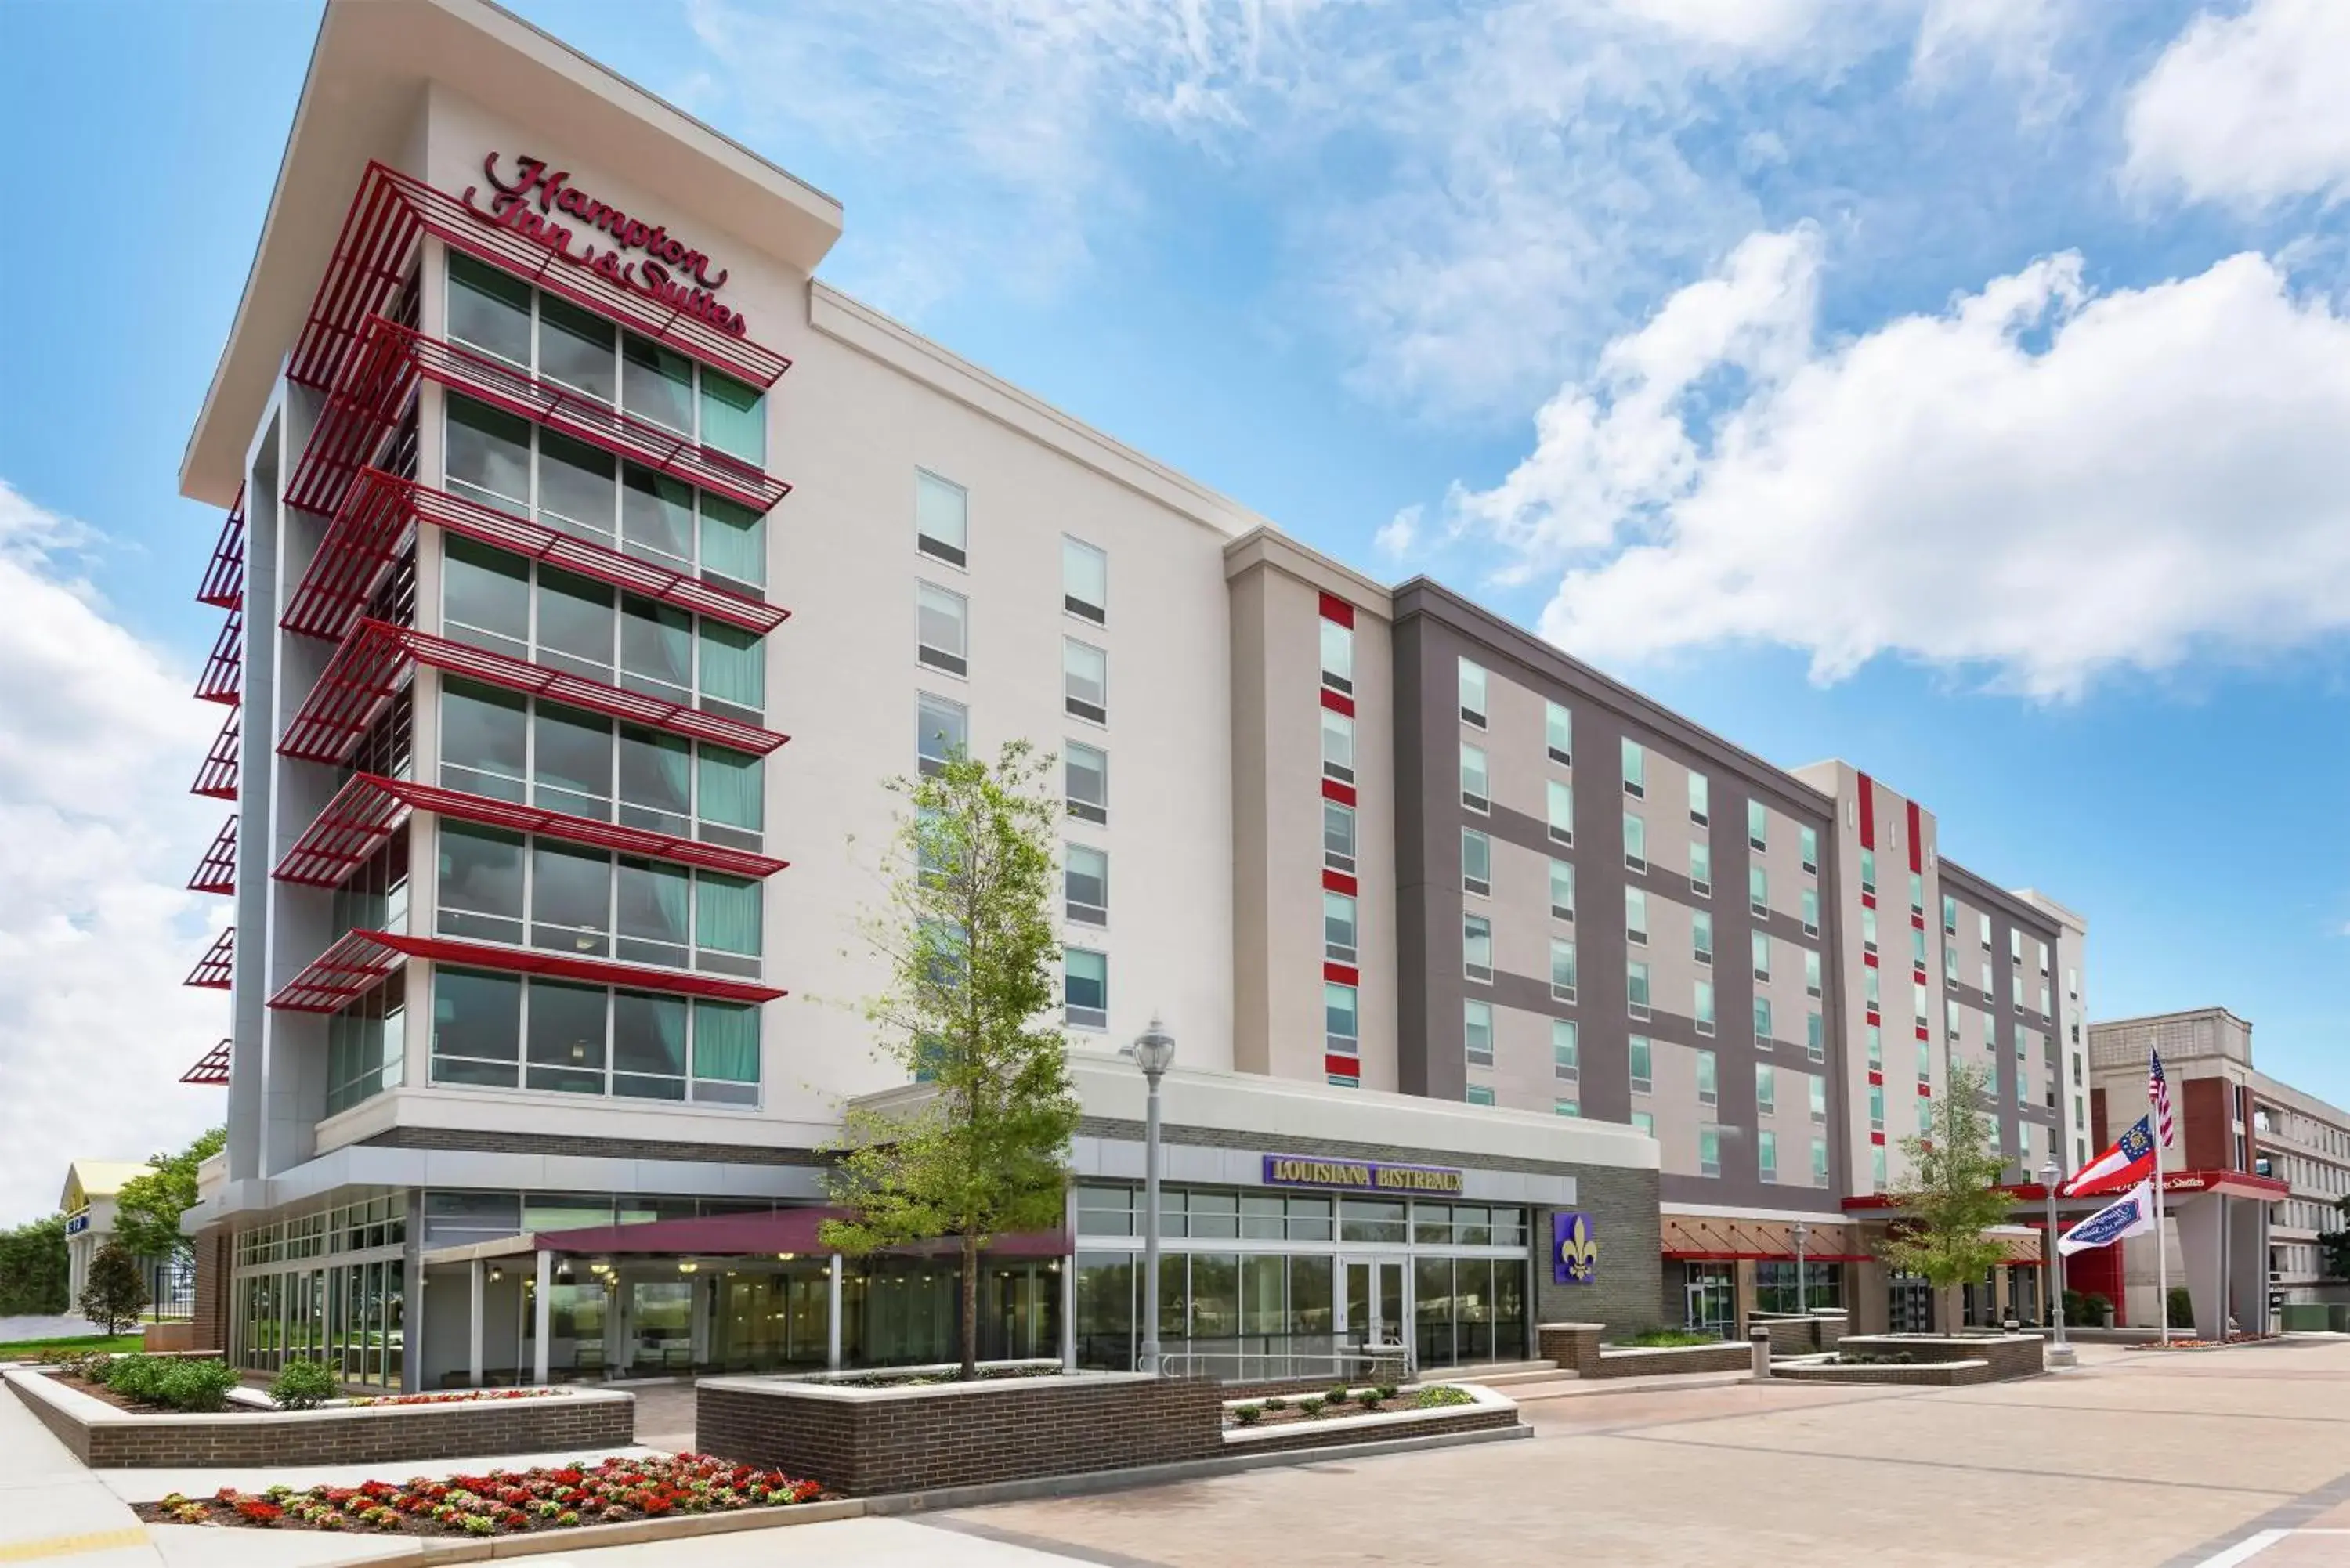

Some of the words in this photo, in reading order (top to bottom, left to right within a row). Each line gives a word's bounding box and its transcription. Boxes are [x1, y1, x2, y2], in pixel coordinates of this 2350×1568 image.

[463, 186, 594, 263] Inn
[593, 250, 619, 283] &
[624, 259, 747, 338] Suites
[484, 151, 728, 290] Hampton
[1274, 1159, 1372, 1186] LOUISIANA
[1376, 1166, 1463, 1191] BISTREAUX
